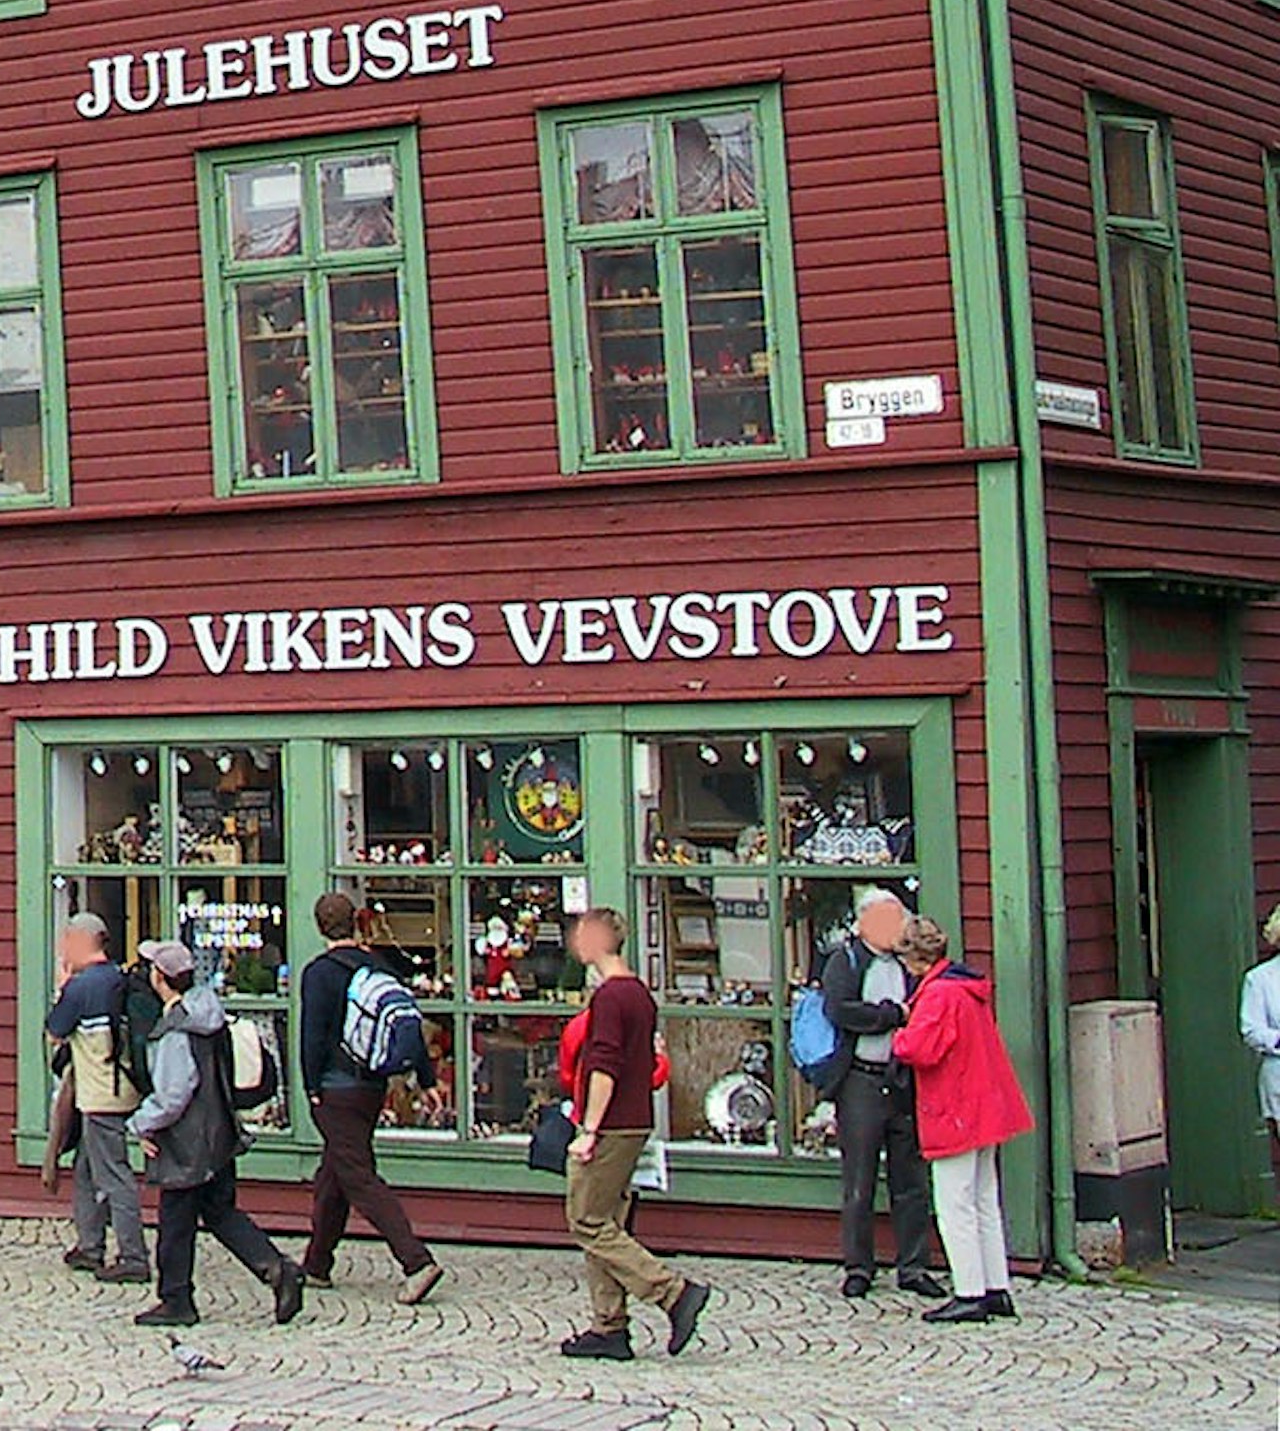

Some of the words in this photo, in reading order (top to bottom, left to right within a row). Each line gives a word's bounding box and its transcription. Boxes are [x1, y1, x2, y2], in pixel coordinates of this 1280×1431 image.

[76, 4, 504, 119] JULEHUSET
[840, 388, 925, 414] Bryggen
[188, 602, 477, 676] VIKENS
[500, 584, 954, 665] VEVSTOVE
[186, 903, 270, 918] CHRISTMAS
[209, 918, 248, 932] SHOP
[194, 932, 264, 947] UPSTAIRS
